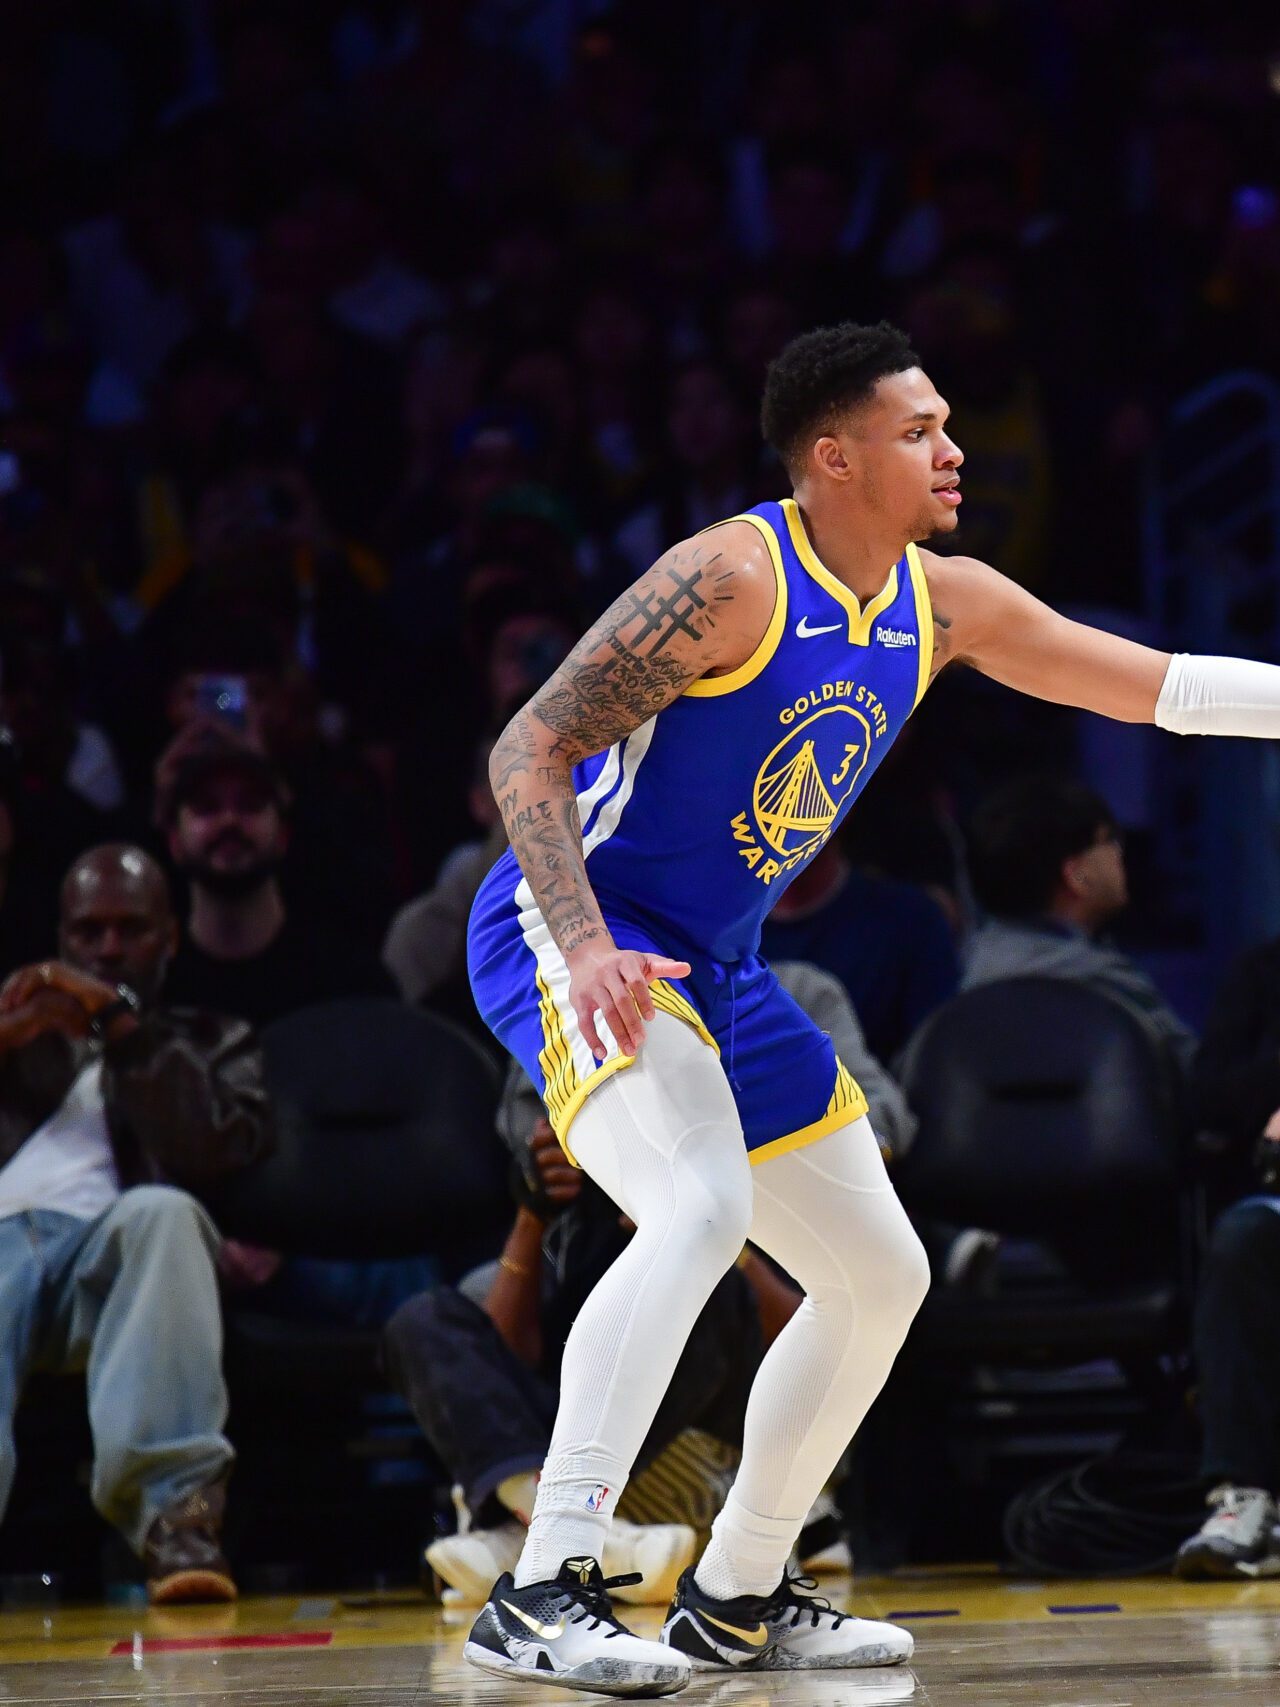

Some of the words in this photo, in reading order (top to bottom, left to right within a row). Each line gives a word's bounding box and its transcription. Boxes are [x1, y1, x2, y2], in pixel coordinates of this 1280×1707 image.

[876, 626, 917, 647] Rakuten
[779, 681, 854, 724] GOLDEN
[855, 686, 889, 738] STATE
[831, 744, 860, 785] 3
